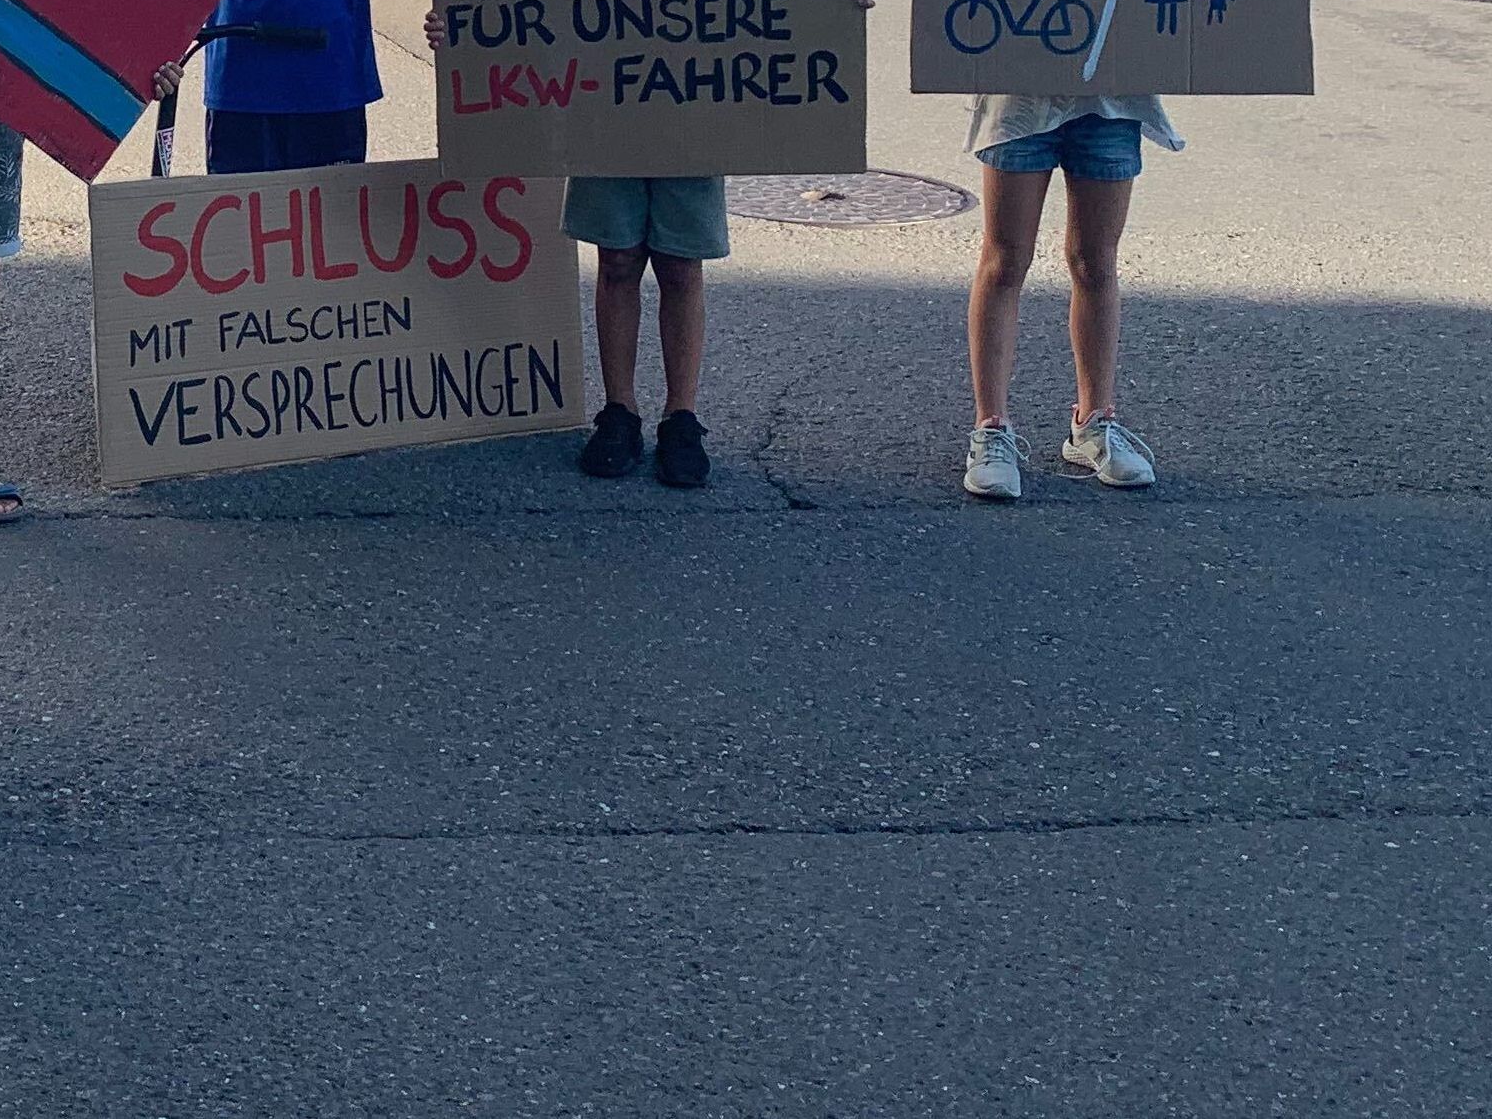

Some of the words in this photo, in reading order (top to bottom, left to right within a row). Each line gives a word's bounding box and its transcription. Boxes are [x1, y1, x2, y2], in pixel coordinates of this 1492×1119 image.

[451, 57, 600, 114] LKW-
[614, 50, 849, 106] FAHRER
[123, 176, 533, 297] SCHLUSS
[130, 318, 193, 368] MIT
[219, 297, 412, 353] FALSCHEN
[129, 339, 565, 447] VERSPRECHUNGEN
